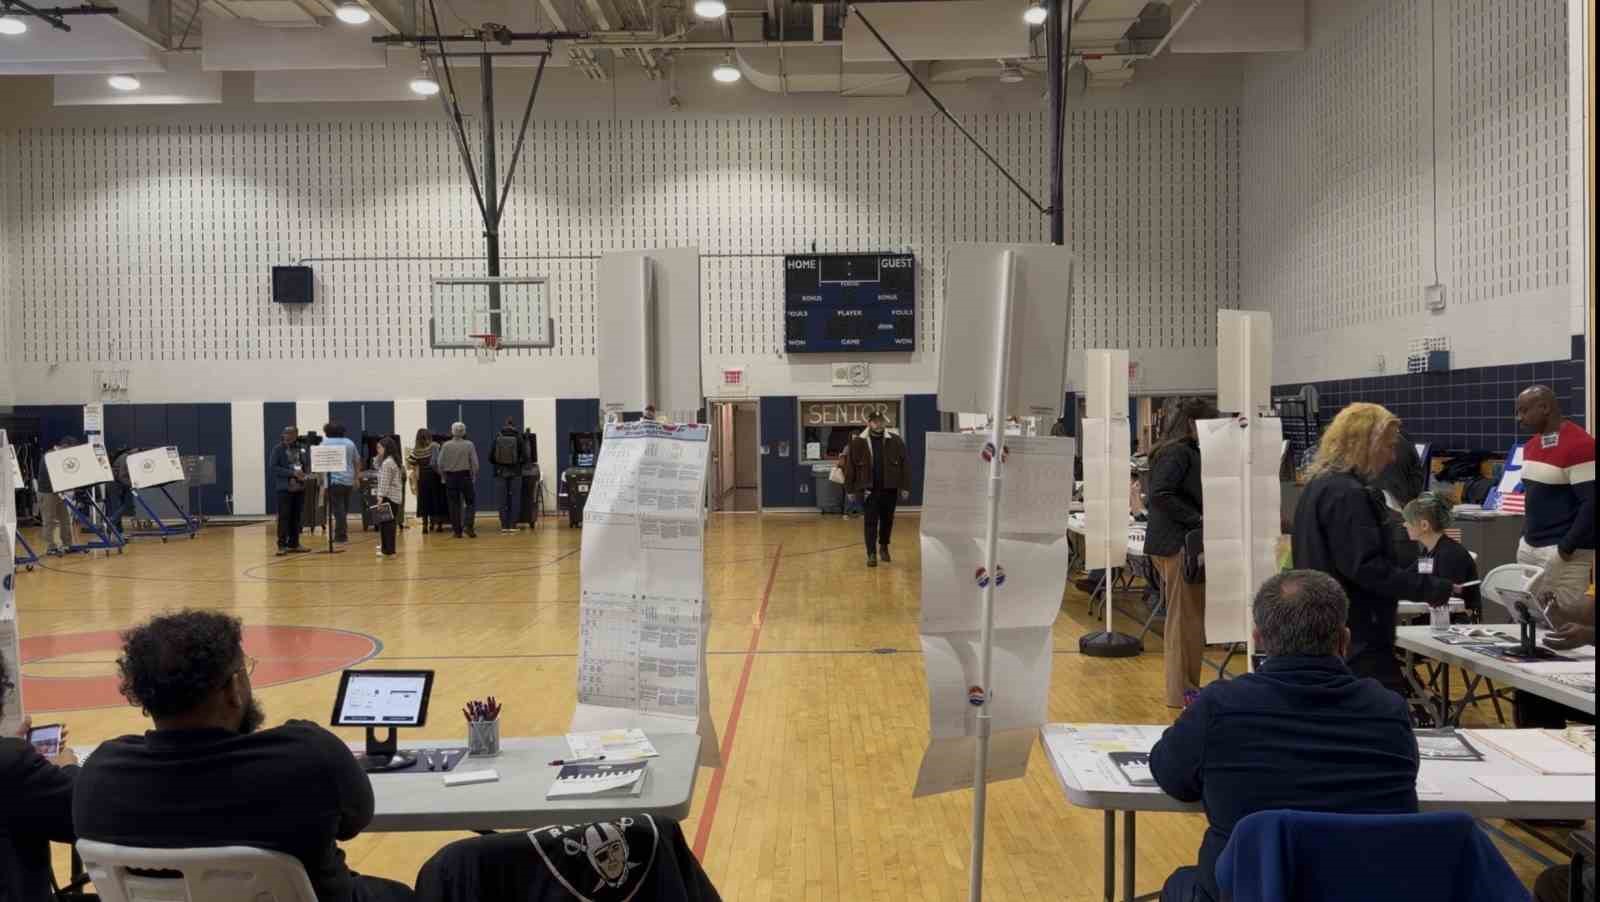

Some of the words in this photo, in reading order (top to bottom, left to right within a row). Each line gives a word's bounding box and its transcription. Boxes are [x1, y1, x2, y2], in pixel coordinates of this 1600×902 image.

[787, 260, 816, 269] HOME
[881, 258, 912, 268] GUEST
[809, 403, 891, 424] SENIOR
